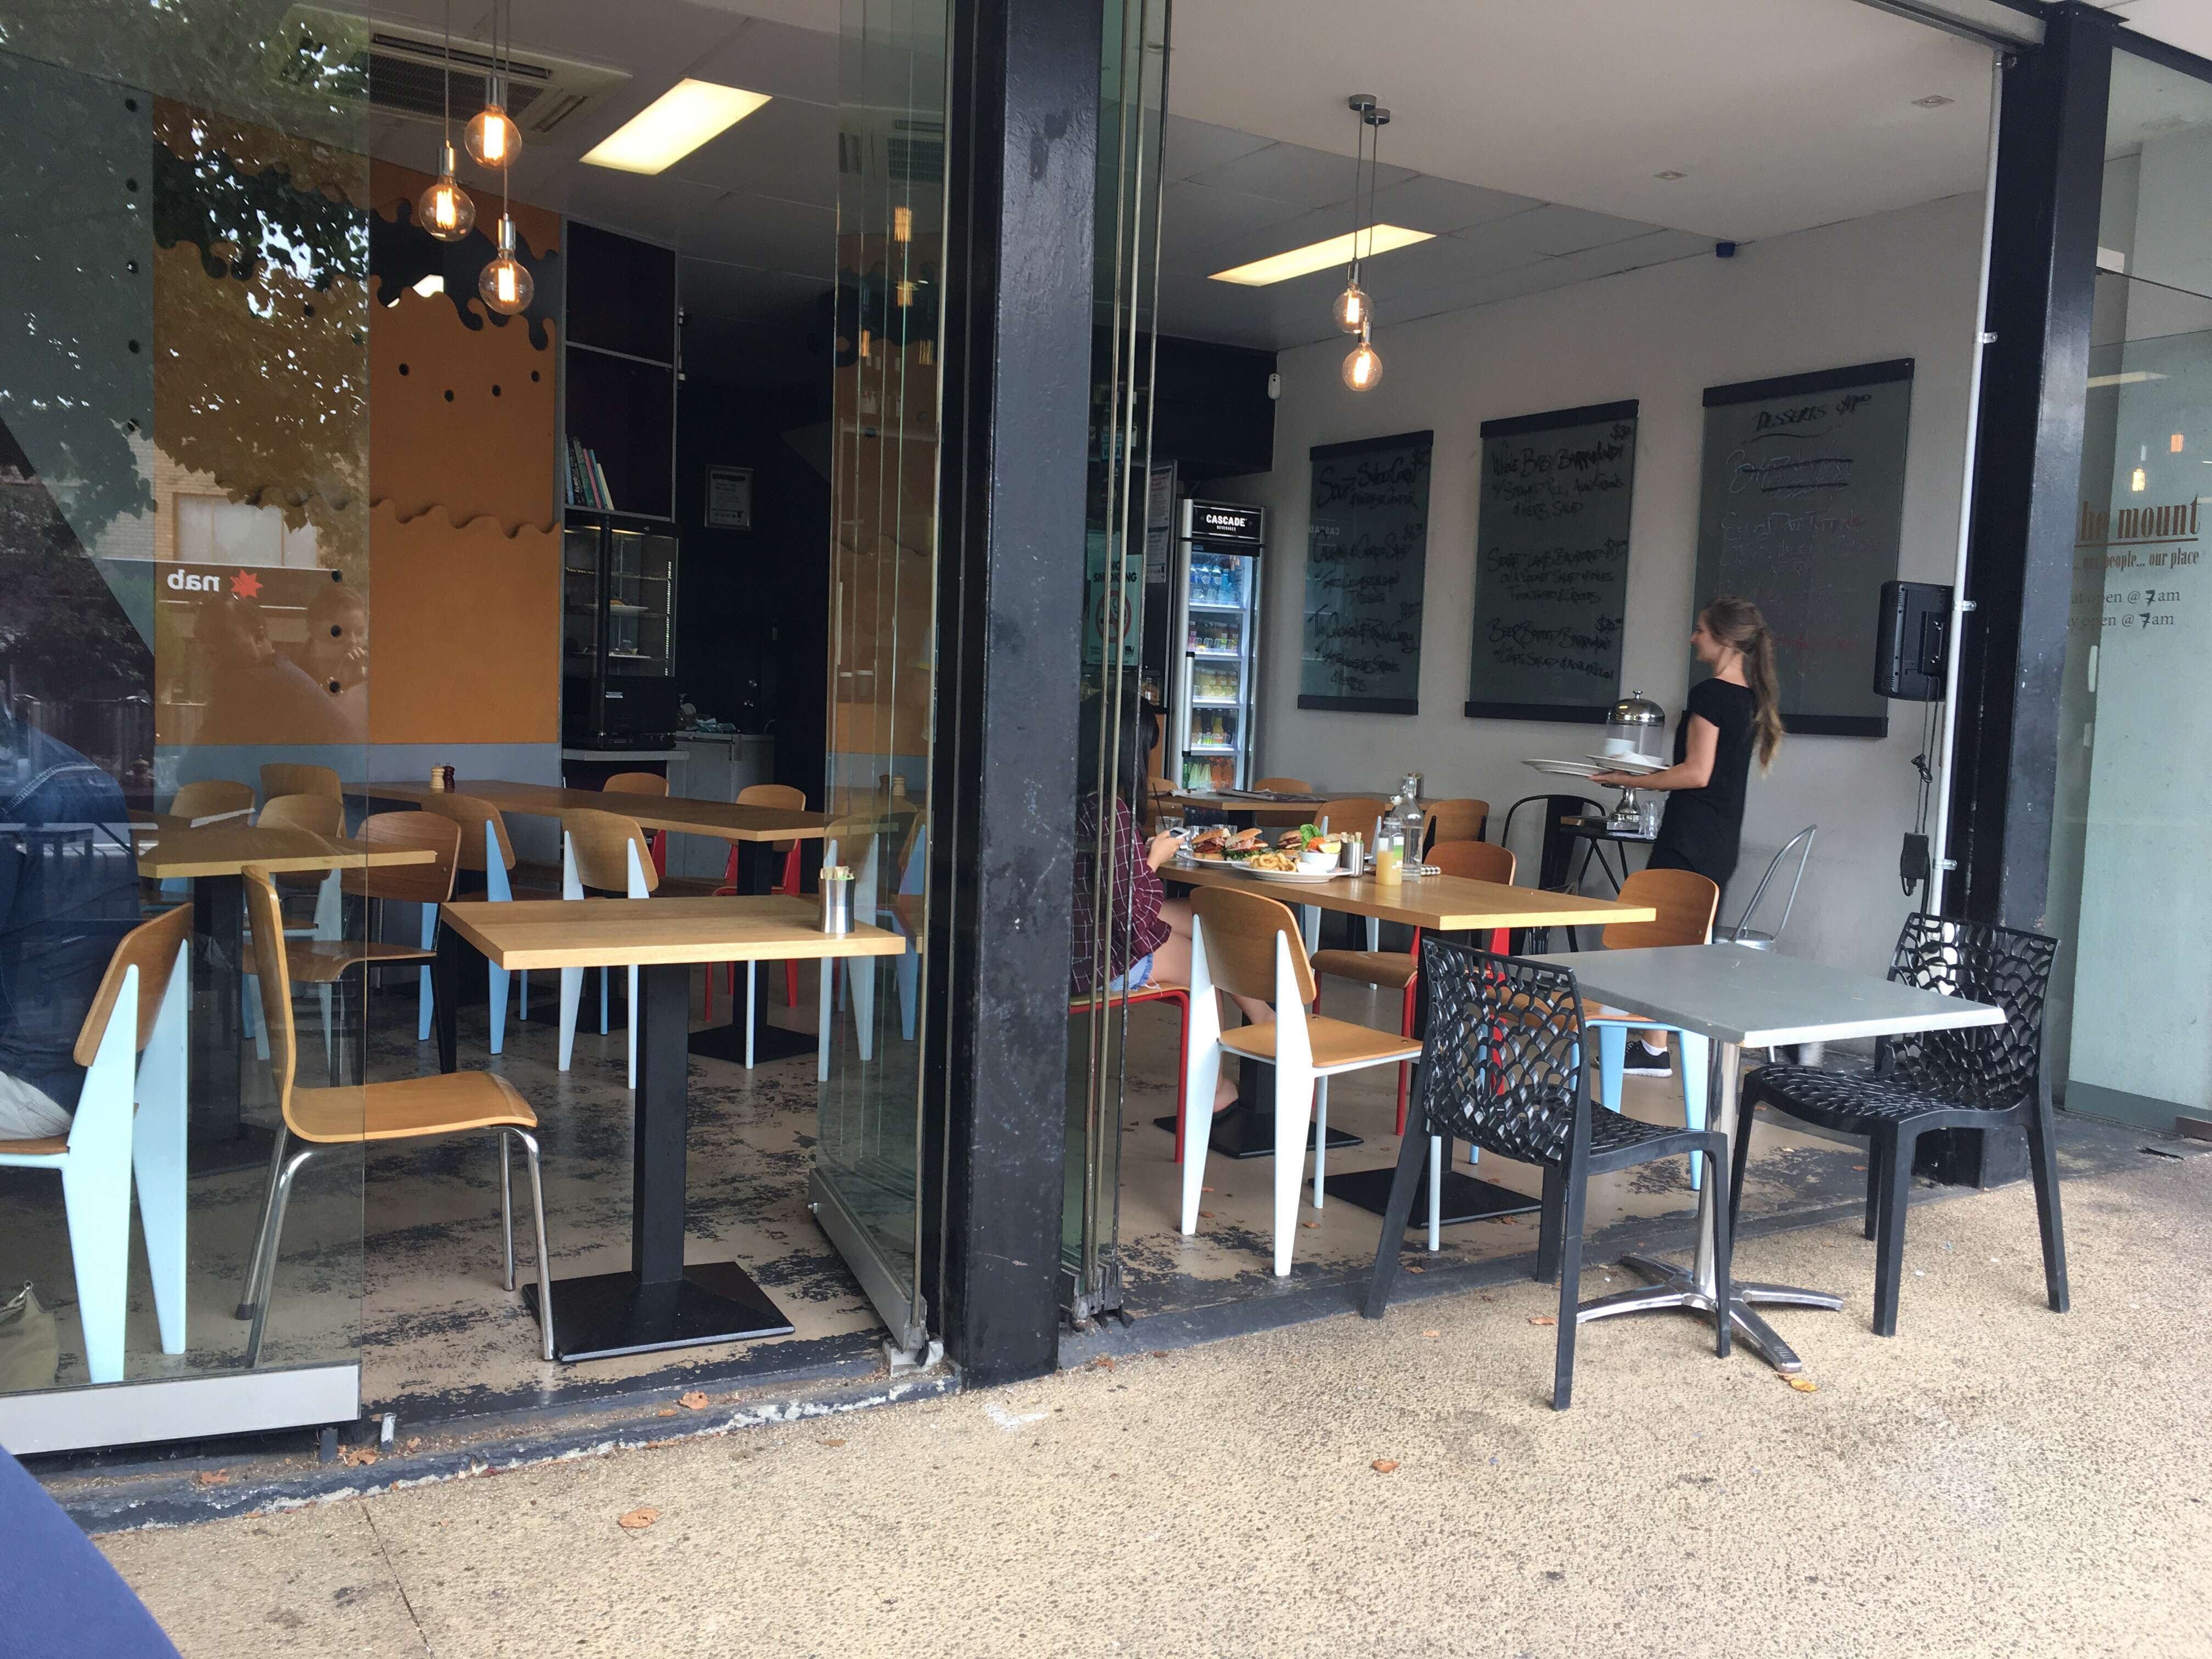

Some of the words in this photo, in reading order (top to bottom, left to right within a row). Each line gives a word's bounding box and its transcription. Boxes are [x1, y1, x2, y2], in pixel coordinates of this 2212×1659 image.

[1206, 514, 1246, 527] CASCADE
[2118, 493, 2200, 539] mount
[2149, 554, 2168, 567] our
[2170, 548, 2199, 568] place
[2128, 591, 2140, 603] @
[2121, 614, 2134, 627] @
